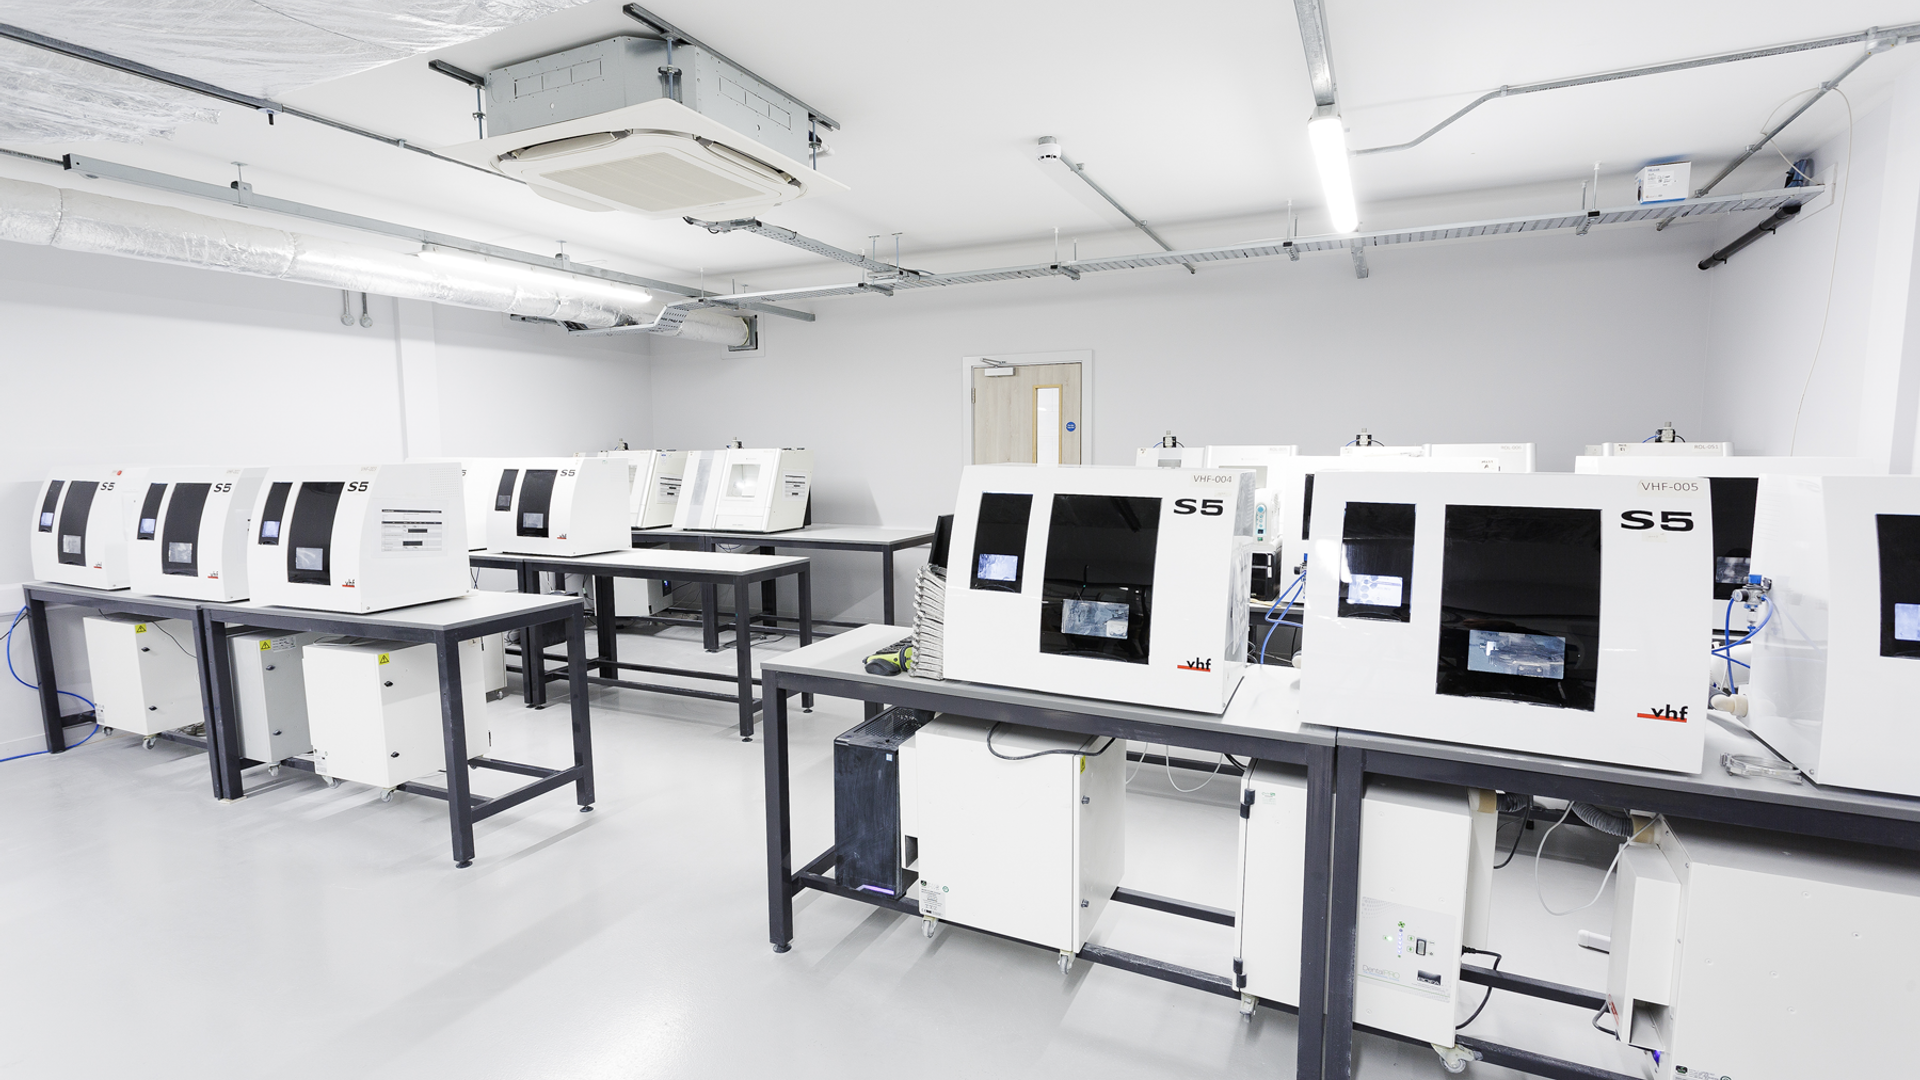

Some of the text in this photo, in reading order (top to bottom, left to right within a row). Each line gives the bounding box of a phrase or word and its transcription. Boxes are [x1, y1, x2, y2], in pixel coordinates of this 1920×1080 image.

[560, 469, 576, 477] S5
[1194, 475, 1232, 484] VHF-004
[100, 482, 115, 491] S5
[213, 483, 232, 493] S5
[347, 481, 369, 492] S5
[1641, 482, 1699, 492] VHF-005
[1174, 498, 1224, 517] S5
[1620, 510, 1694, 532] S5
[1186, 657, 1211, 670] vhf
[1651, 704, 1689, 720] vhf
